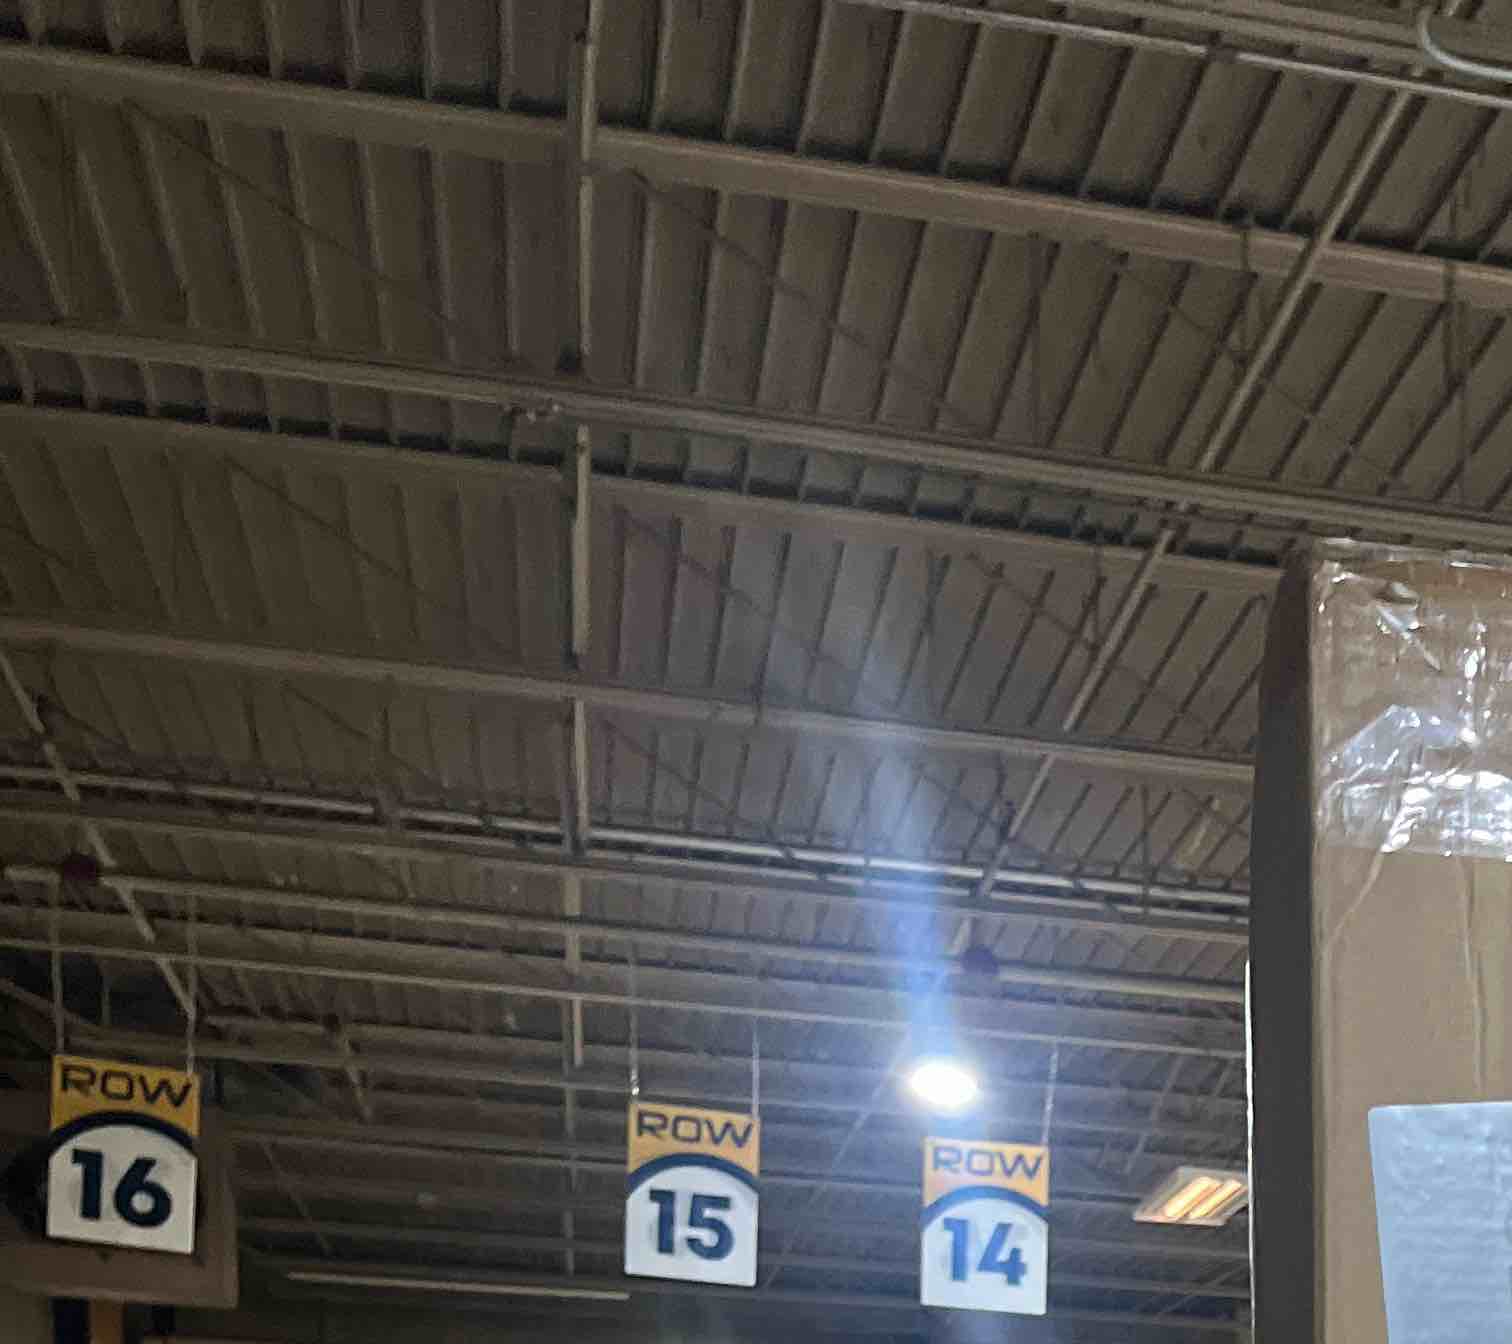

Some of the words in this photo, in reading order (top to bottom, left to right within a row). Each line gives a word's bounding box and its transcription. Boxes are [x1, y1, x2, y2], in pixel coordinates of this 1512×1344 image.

[61, 1063, 193, 1108] ROW
[637, 1110, 754, 1148] ROW
[71, 1147, 172, 1229] 16
[932, 1146, 1042, 1180] ROW
[649, 1188, 735, 1262] 15
[942, 1217, 1028, 1287] 14
